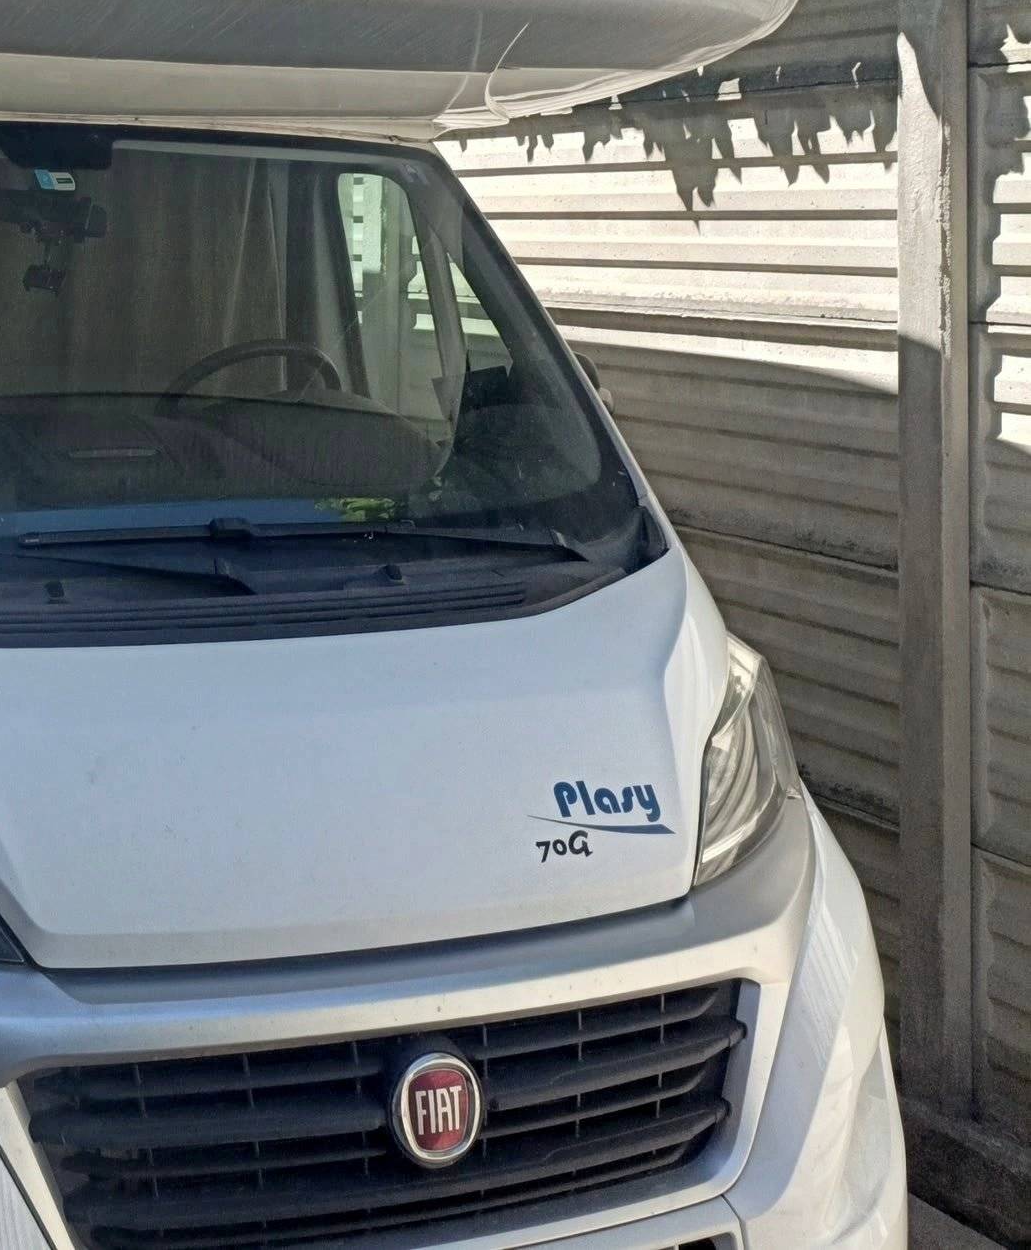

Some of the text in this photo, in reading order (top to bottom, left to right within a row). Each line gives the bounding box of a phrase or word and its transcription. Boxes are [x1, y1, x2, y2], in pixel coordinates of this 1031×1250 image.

[553, 780, 661, 823] Plasy
[535, 829, 593, 863] 70G
[415, 1085, 462, 1136] FIAT
